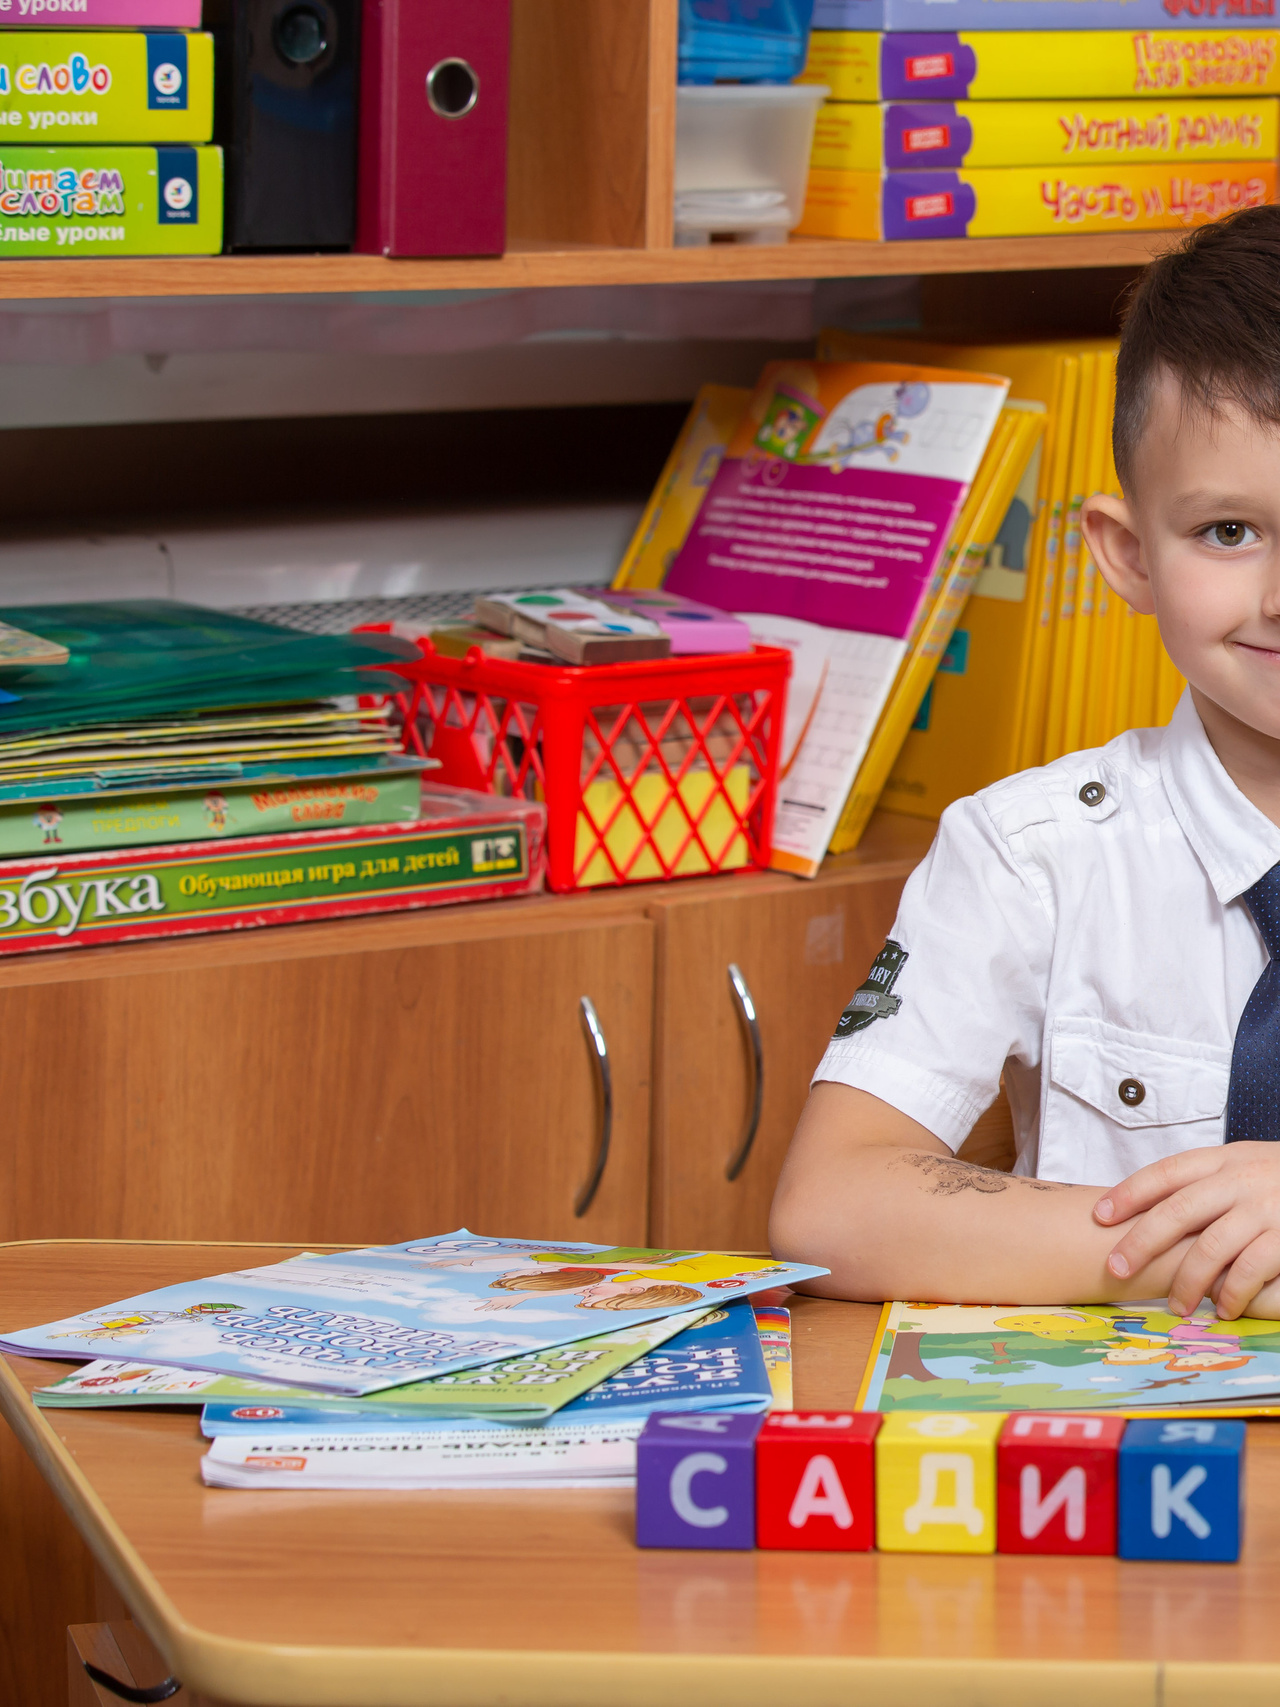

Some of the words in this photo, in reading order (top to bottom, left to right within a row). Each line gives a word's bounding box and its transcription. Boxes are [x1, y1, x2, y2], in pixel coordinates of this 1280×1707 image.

[18, 0, 87, 15] уроки
[16, 53, 111, 94] слово
[27, 111, 98, 129] уроки
[0, 191, 124, 216] слогам
[56, 227, 125, 245] уроки
[0, 866, 166, 936] збука
[179, 866, 304, 898] Обучающая
[308, 864, 355, 885] игра
[359, 856, 400, 878] для
[403, 847, 460, 873] детей
[868, 966, 891, 984] ARY
[265, 1305, 454, 1347] ЧИТАТЬ
[212, 1314, 476, 1361] ГОВОРИТЬ
[452, 1340, 515, 1352] И
[219, 1332, 388, 1367] УЧУСЬ
[689, 1347, 740, 1361] И
[373, 1359, 434, 1371] Я
[510, 1373, 571, 1385] Я
[694, 1368, 743, 1382] Я
[251, 1439, 589, 1452] ТЕТРАДЬ-ПРОПИСИ
[670, 1452, 1212, 1543] САДИК
